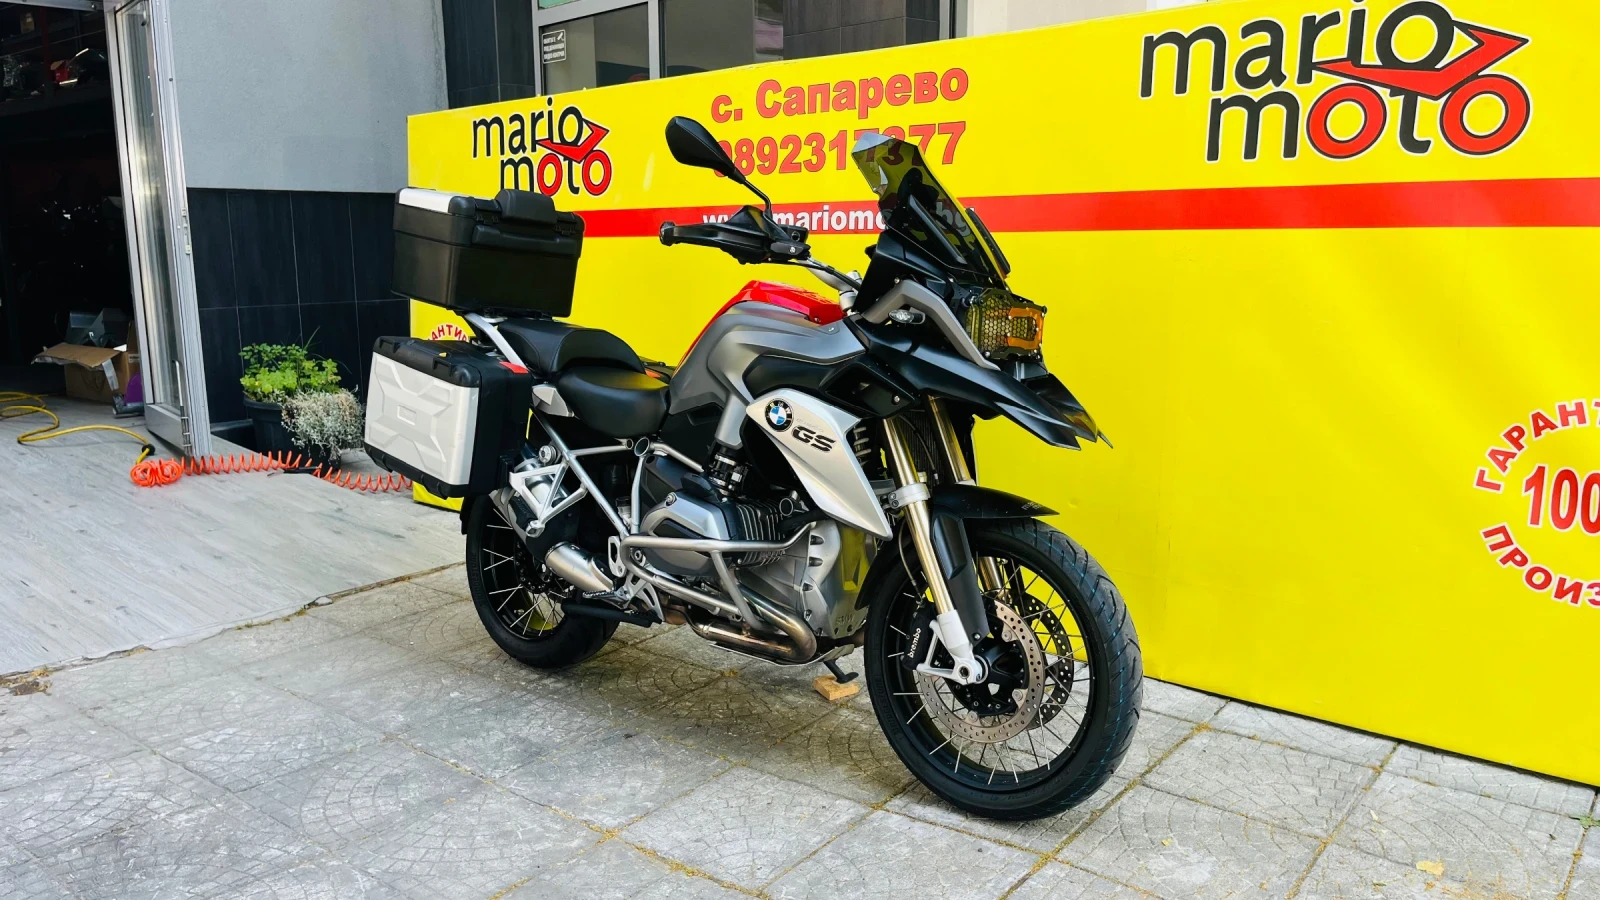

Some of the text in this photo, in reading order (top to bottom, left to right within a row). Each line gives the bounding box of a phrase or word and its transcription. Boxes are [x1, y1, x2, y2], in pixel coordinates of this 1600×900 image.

[1140, 0, 1455, 98] mario
[472, 97, 584, 158] mario
[711, 67, 969, 124] с. Сапарево
[1206, 74, 1531, 161] moto
[500, 149, 612, 197] moto
[791, 425, 836, 452] GS
[1475, 401, 1600, 492] ГАРАН
[1524, 465, 1600, 534] 100
[1482, 525, 1600, 607] ПРОИЗ
[907, 627, 922, 659] brembo
